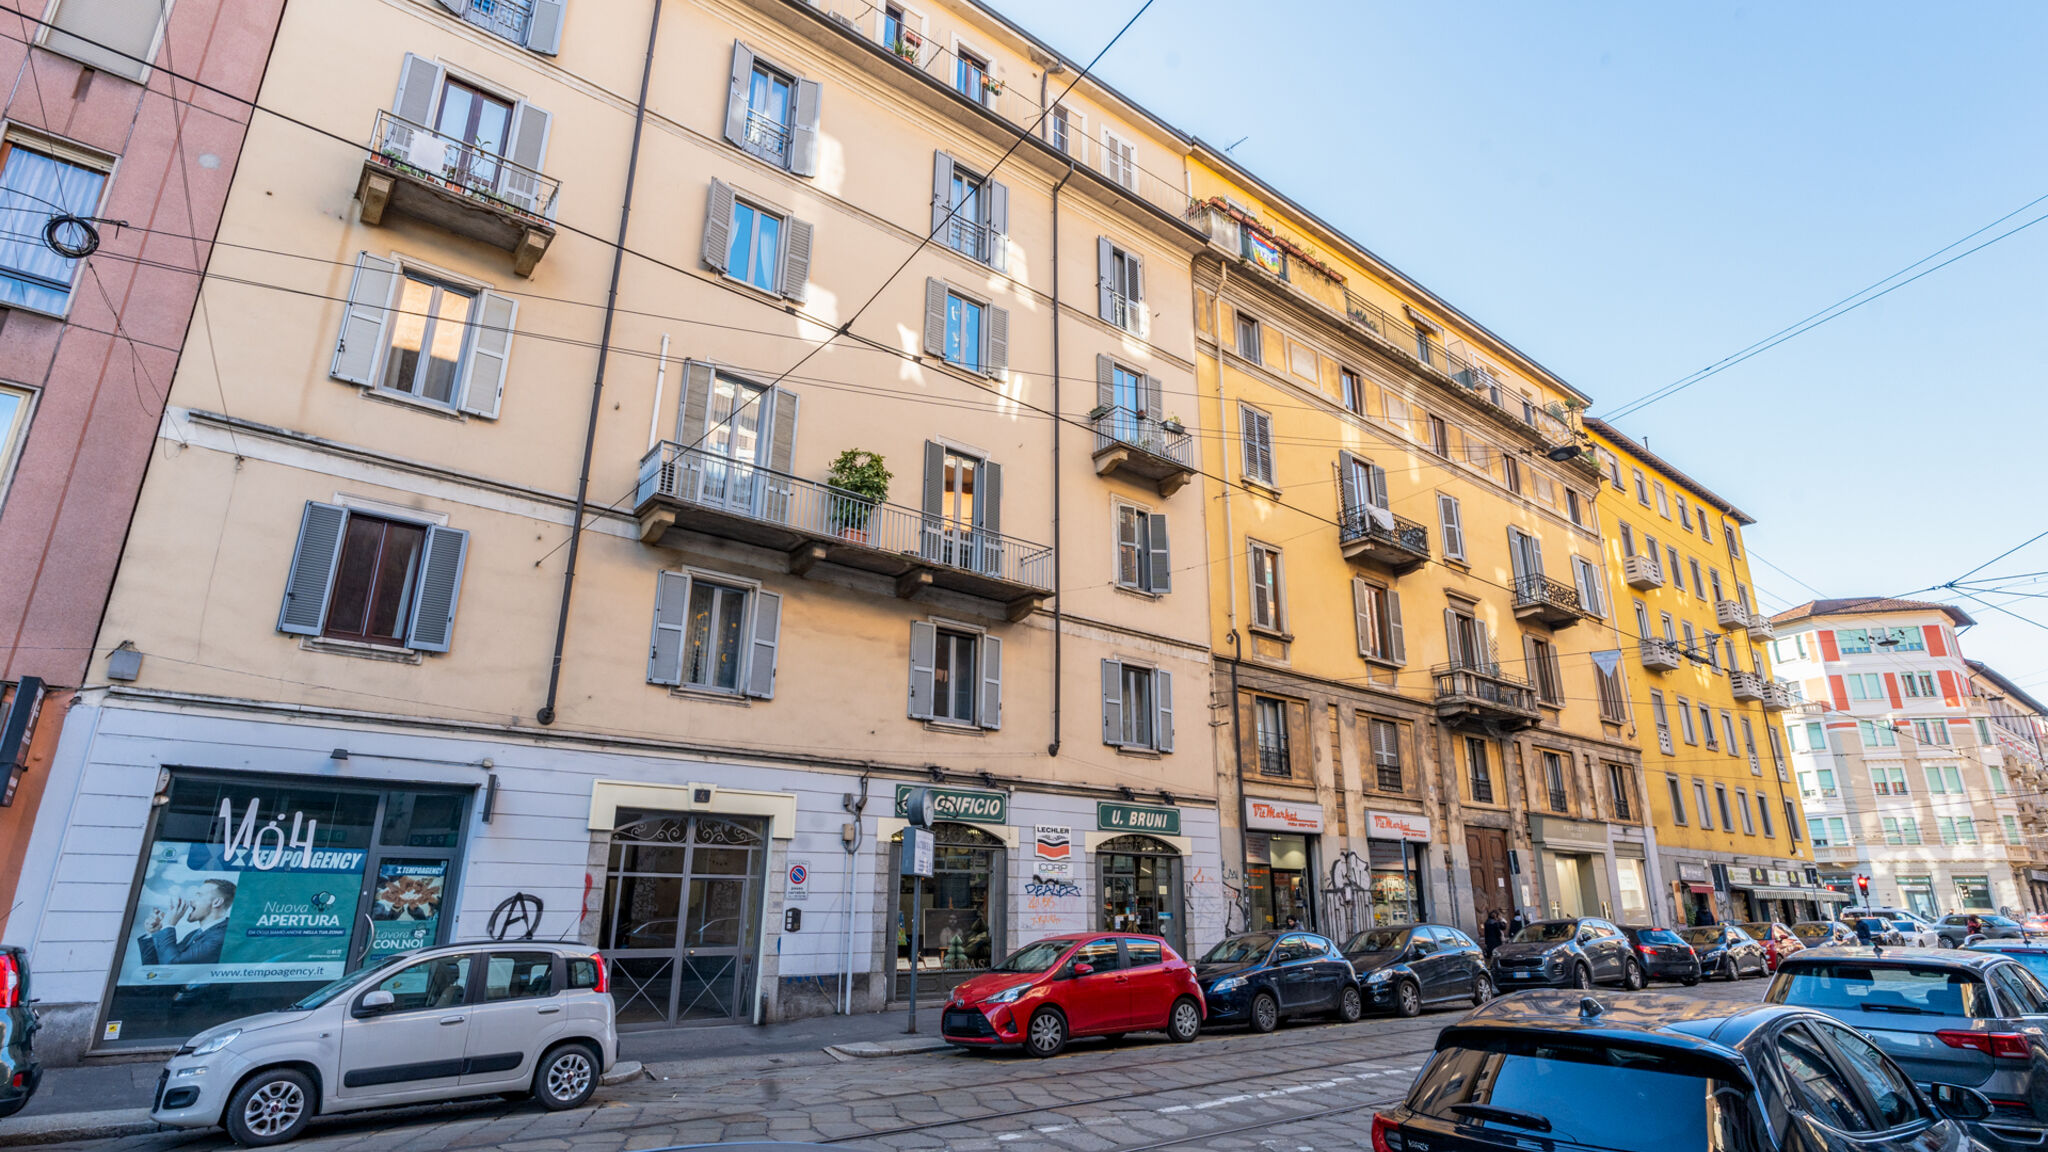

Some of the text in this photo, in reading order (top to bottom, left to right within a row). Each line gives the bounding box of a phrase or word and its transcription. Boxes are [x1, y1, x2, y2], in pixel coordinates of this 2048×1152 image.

[1111, 809, 1168, 828] U. BRUNI
[1037, 826, 1070, 835] LECHLER
[263, 901, 309, 914] Nuova
[256, 914, 341, 927] APERTURA
[376, 929, 410, 939] Lavora
[210, 966, 325, 978] www.tempoagency.it
